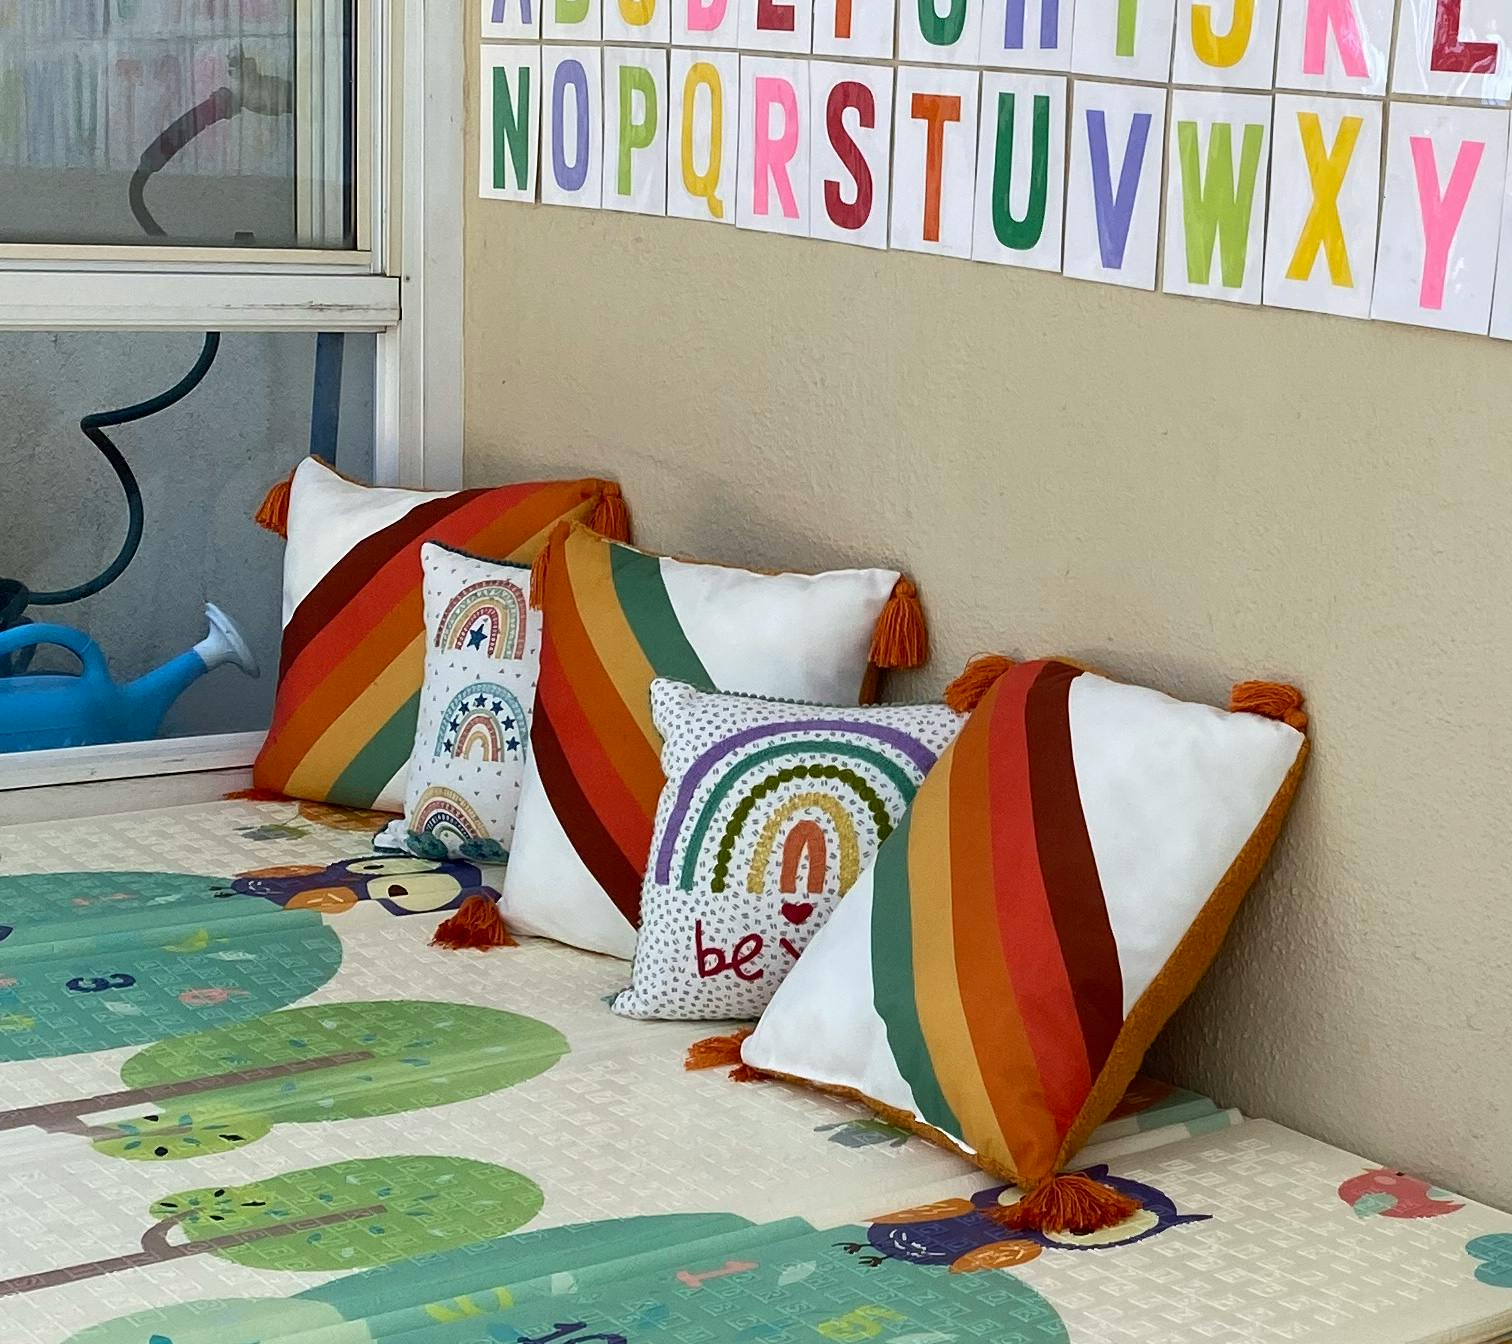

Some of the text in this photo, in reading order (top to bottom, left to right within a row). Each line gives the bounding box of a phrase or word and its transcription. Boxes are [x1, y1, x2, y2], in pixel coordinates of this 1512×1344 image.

[492, 66, 531, 190] N
[551, 59, 590, 192] O
[617, 65, 657, 196] P
[681, 61, 724, 218] Q
[753, 76, 800, 219] R
[823, 81, 875, 230] S
[911, 93, 961, 242] T
[992, 92, 1050, 251] U
[1085, 109, 1153, 270] V
[1176, 120, 1265, 289] W
[1284, 111, 1363, 289] X
[1409, 136, 1486, 310] Y
[695, 918, 764, 981] be
